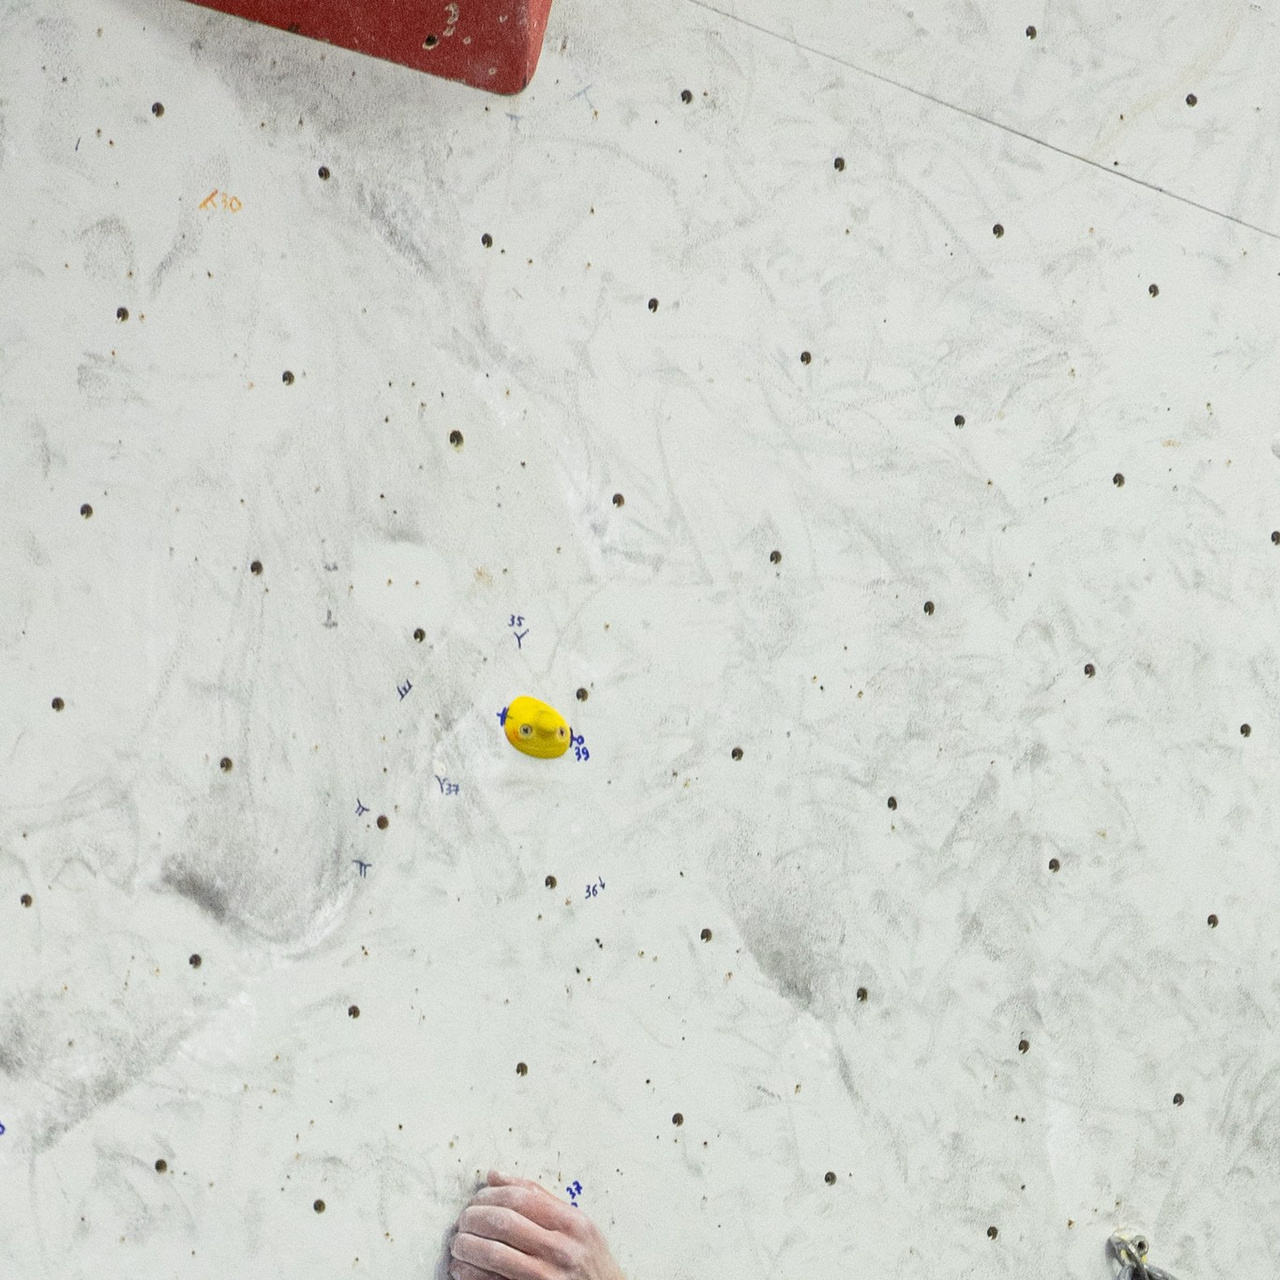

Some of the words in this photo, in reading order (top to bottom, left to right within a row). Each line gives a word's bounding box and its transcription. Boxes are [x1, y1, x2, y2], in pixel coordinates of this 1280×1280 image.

[508, 614, 526, 628] 35
[574, 746, 591, 762] 39
[584, 884, 599, 900] 36
